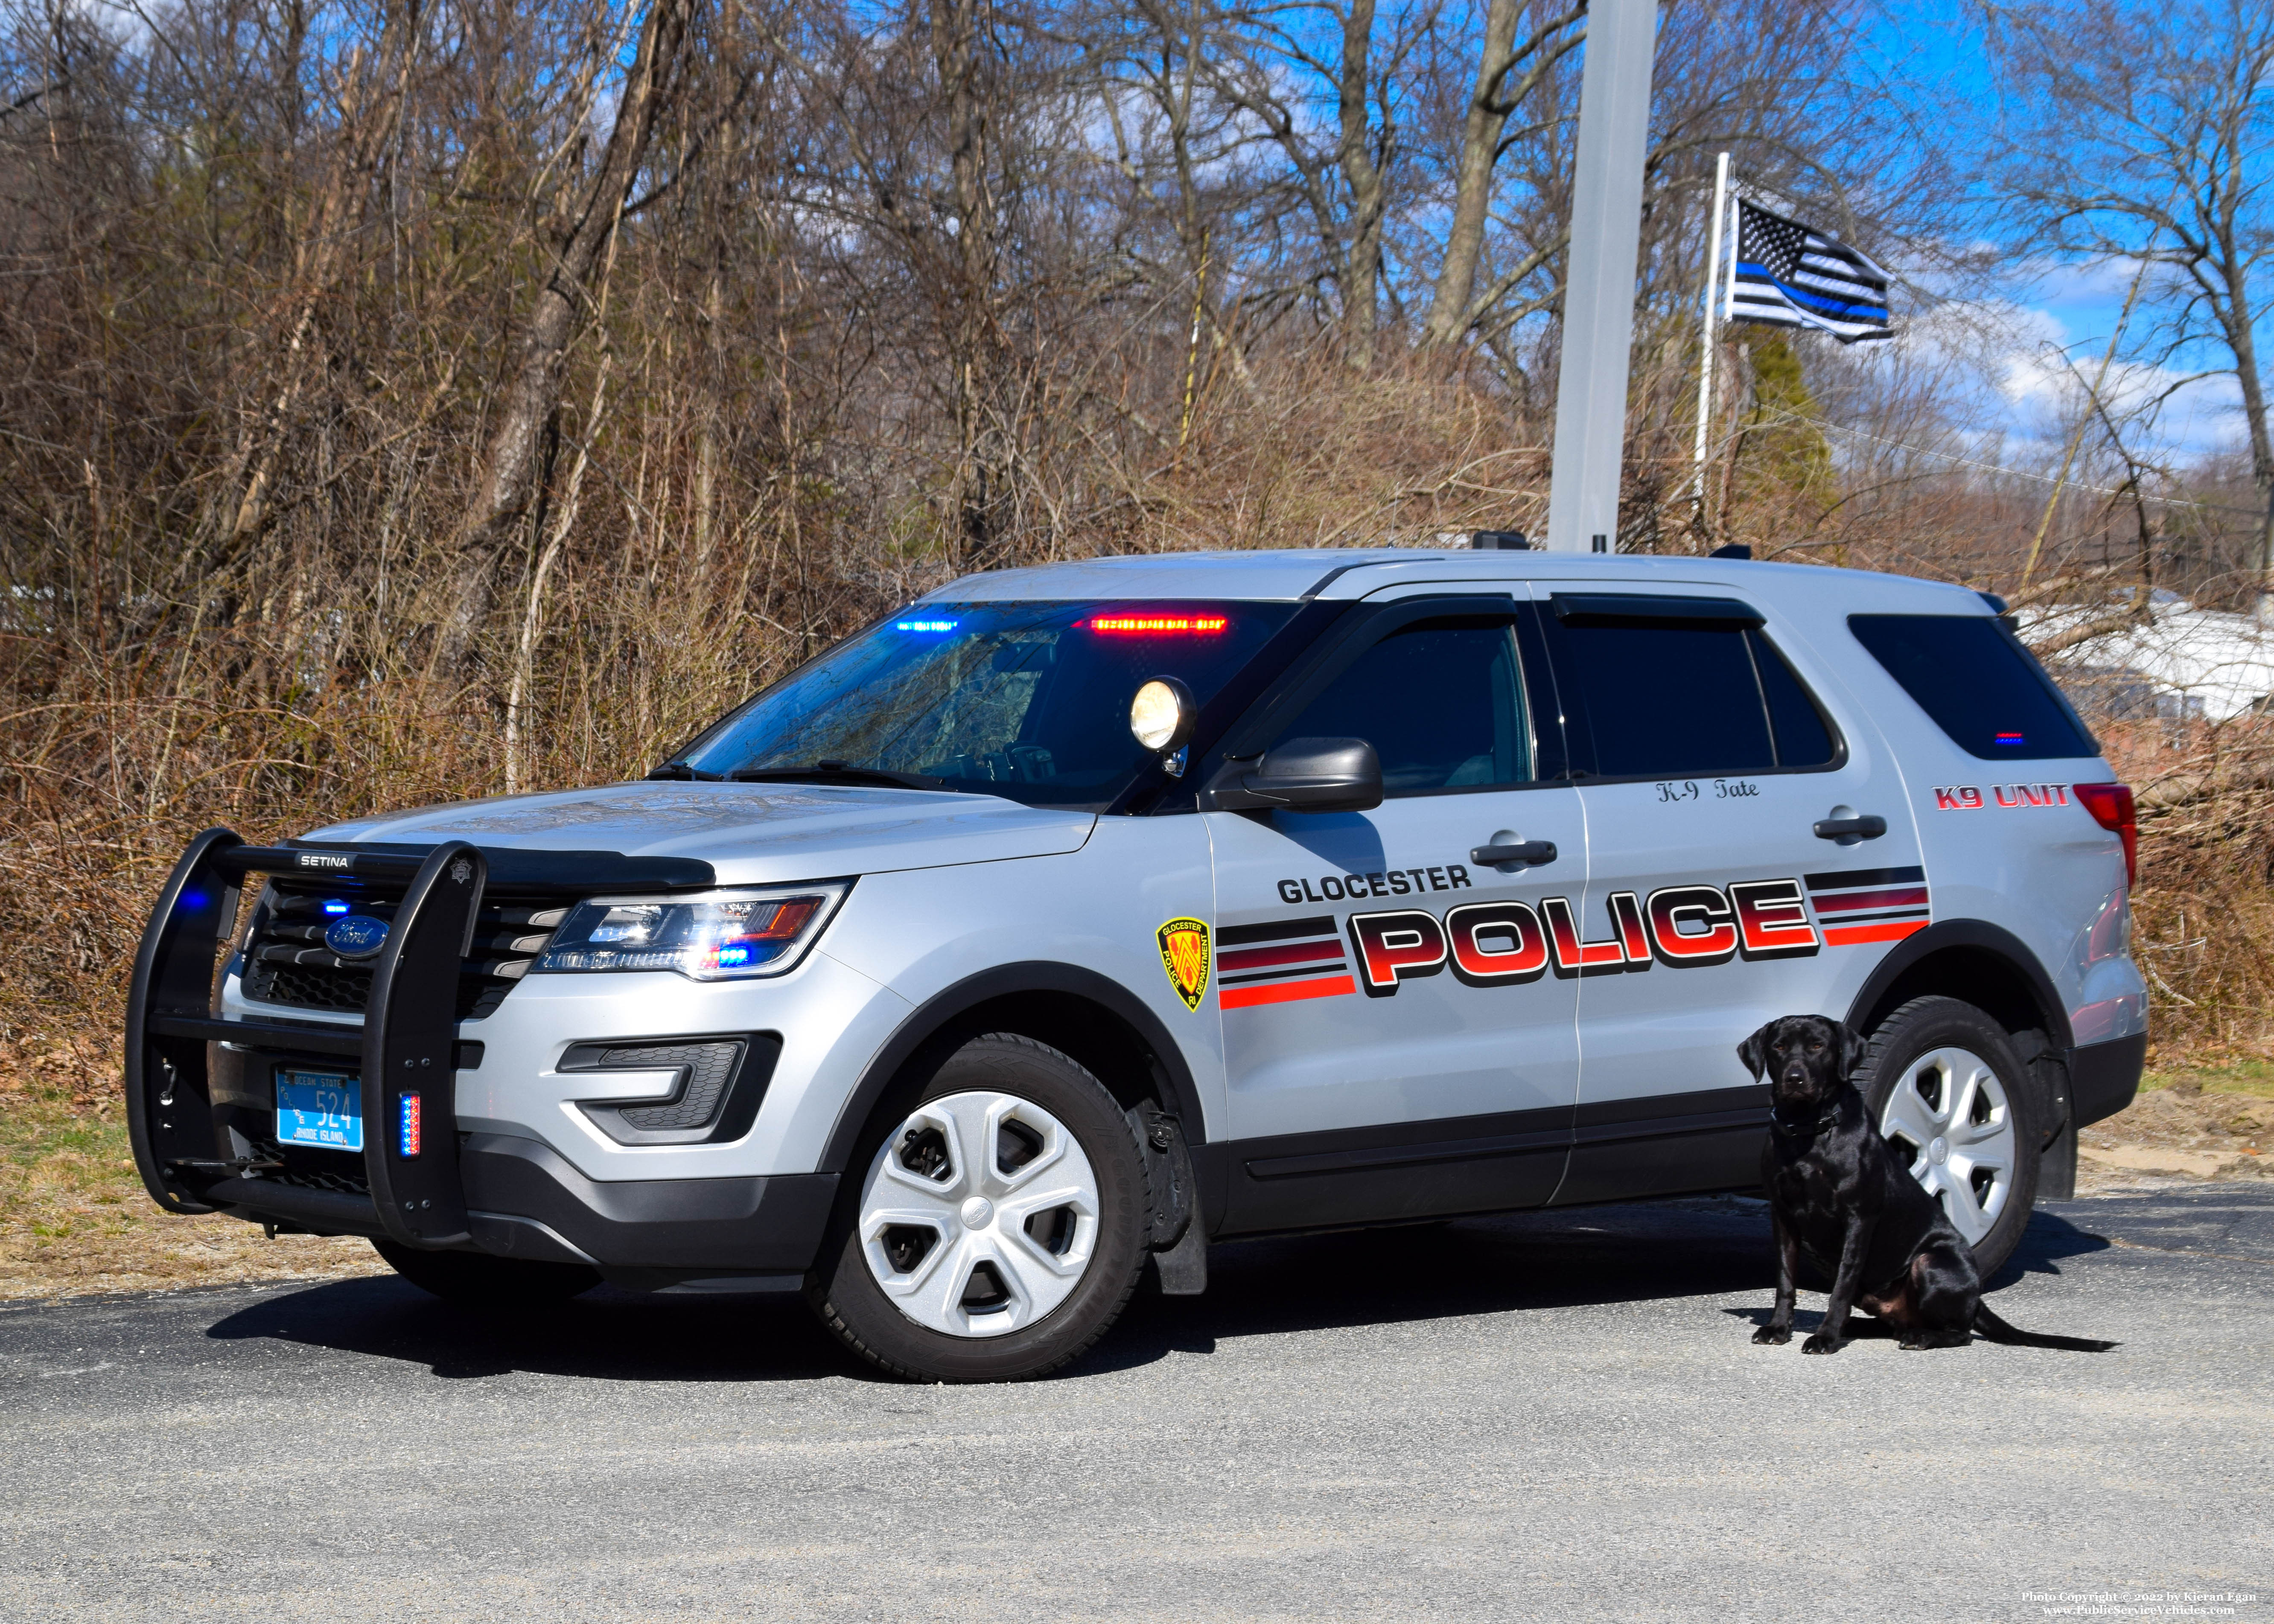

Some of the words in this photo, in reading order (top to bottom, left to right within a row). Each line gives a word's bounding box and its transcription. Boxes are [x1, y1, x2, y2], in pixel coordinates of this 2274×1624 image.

[1656, 781, 1699, 802] K-9
[1714, 779, 1760, 798] Tate
[1931, 784, 1985, 811] K9
[1990, 783, 2070, 808] UNIT
[301, 856, 348, 867] SETINA
[1277, 864, 1472, 904] GLOCESTER
[334, 924, 373, 944] Ford
[1163, 922, 1201, 936] GLOCESTER
[1346, 878, 1819, 998] POLICE
[1163, 950, 1182, 988] POLICE
[1195, 933, 1208, 995] DEPARTMENT
[1188, 995, 1196, 1005] RI
[294, 1076, 316, 1086] OCEAN
[321, 1078, 342, 1089] STATE
[316, 1090, 351, 1129] 524
[297, 1127, 318, 1141] RHODE
[320, 1129, 343, 1143] ISLAND
